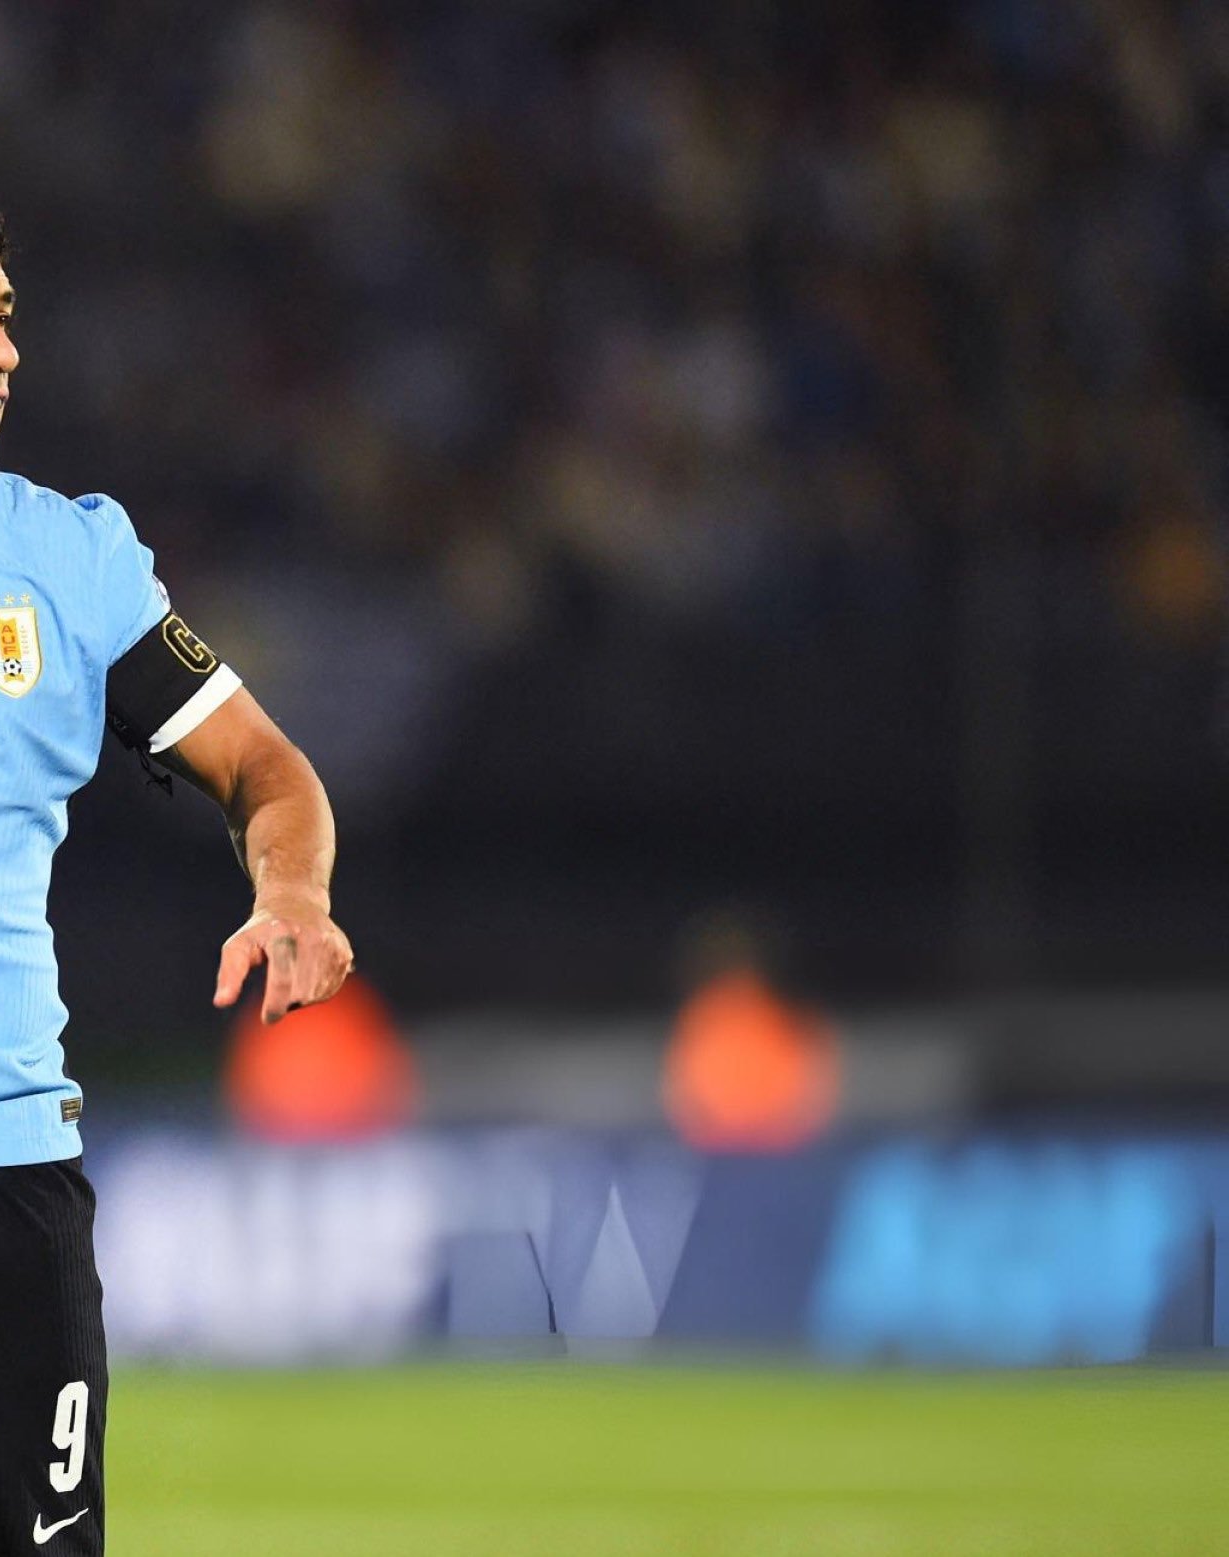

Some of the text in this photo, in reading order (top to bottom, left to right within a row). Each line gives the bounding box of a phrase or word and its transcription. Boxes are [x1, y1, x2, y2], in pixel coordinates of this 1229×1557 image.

[1, 624, 18, 656] AUF
[162, 613, 217, 674] C
[49, 1380, 89, 1493] 9
